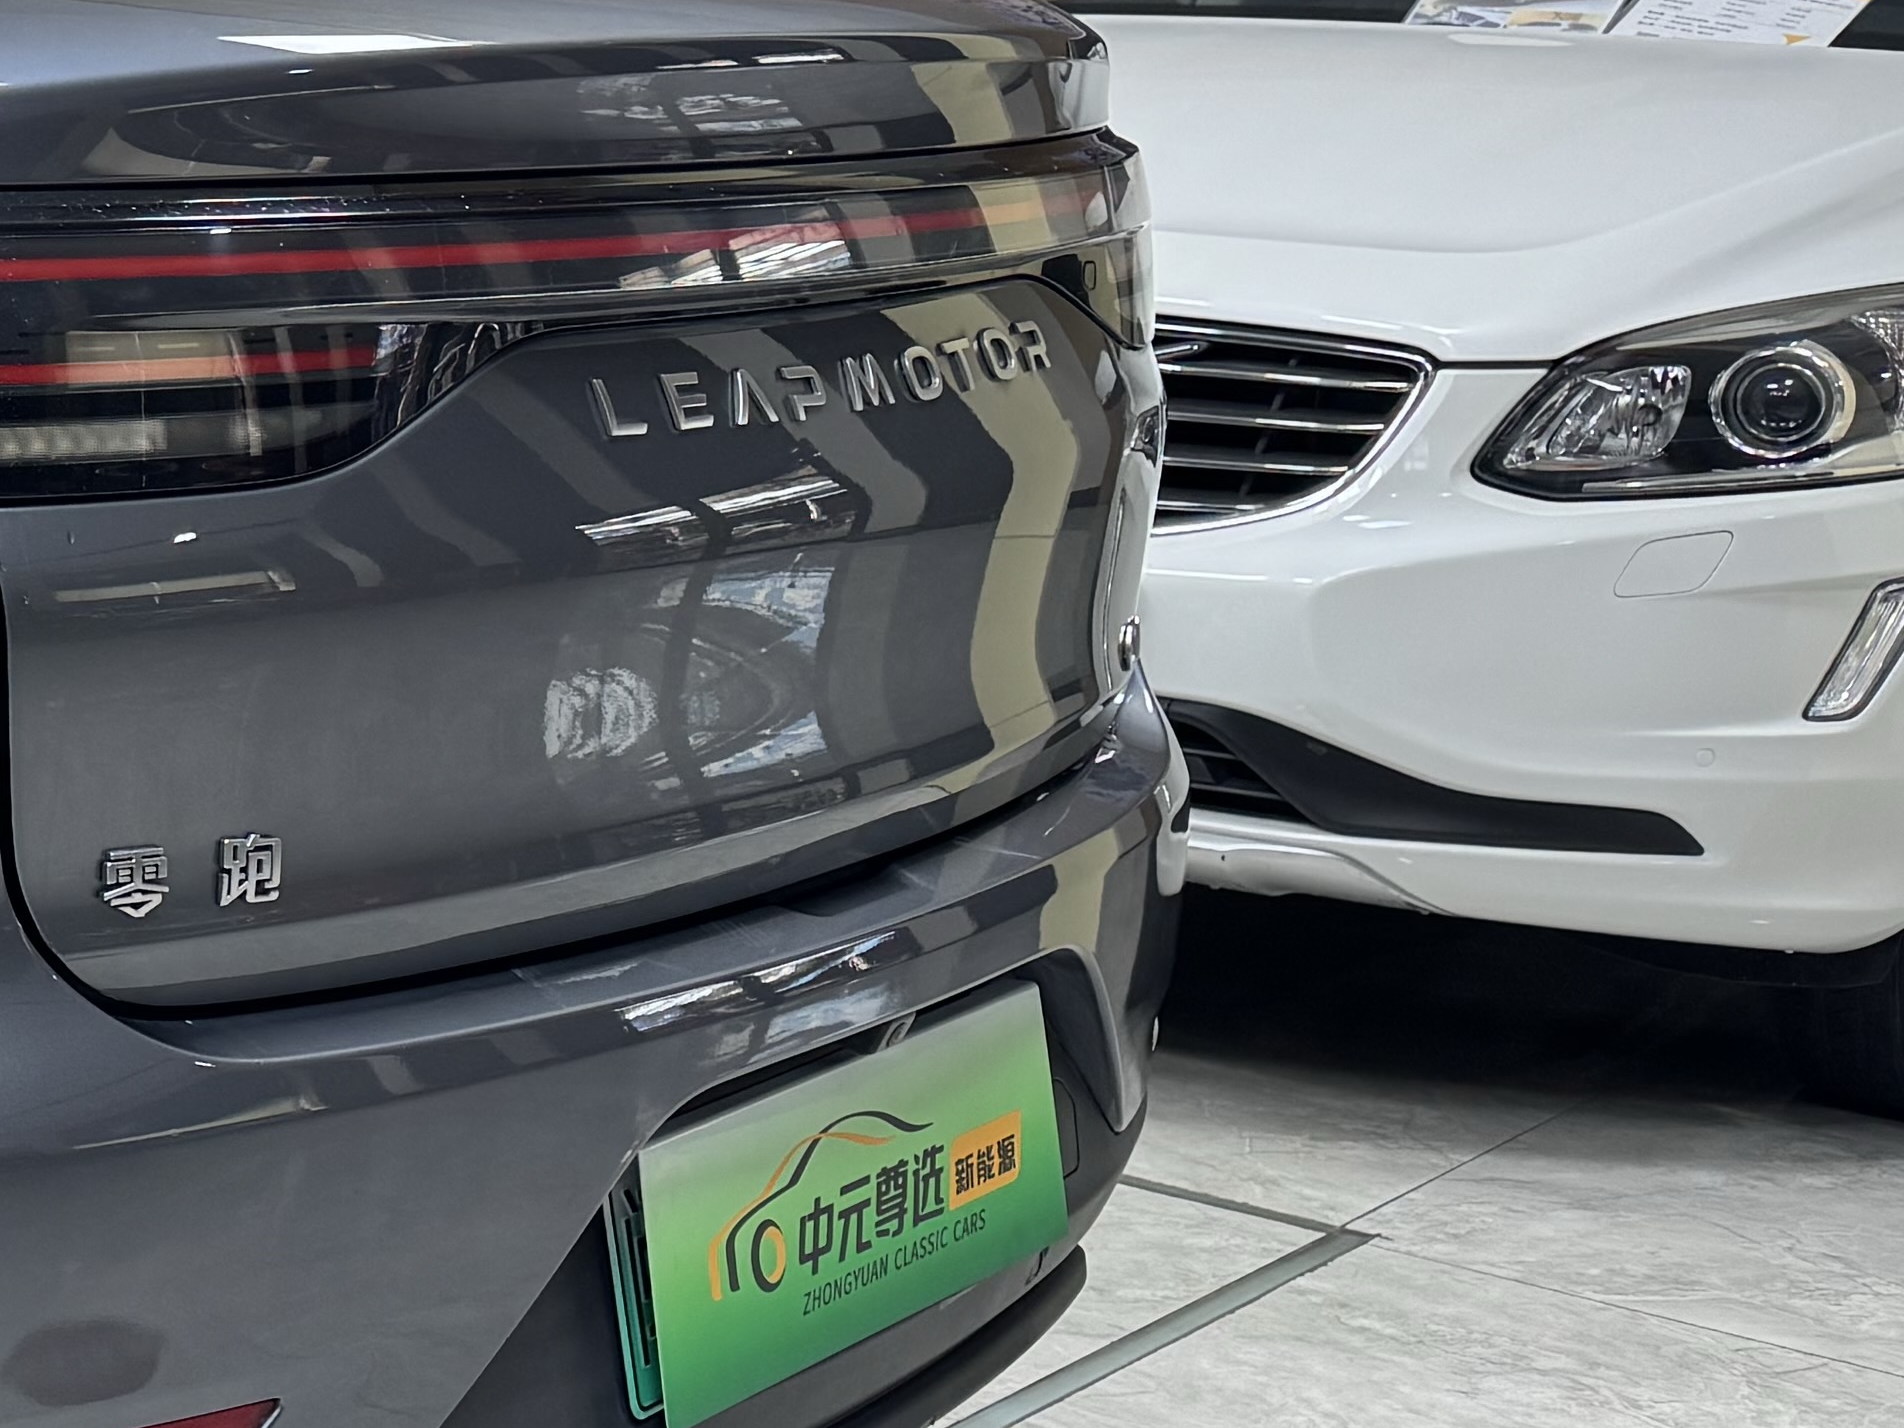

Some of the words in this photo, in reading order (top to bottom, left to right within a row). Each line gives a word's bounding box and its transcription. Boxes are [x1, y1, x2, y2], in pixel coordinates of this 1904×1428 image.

[590, 320, 1053, 437] LEAPMOTOR
[102, 833, 283, 918] 零跑
[799, 1144, 944, 1276] 中元尊选
[955, 1134, 1016, 1195] 新能源
[803, 1254, 889, 1316] ZHONGYUAN
[894, 1227, 948, 1270] CLASSIC
[953, 1209, 986, 1242] CARS
